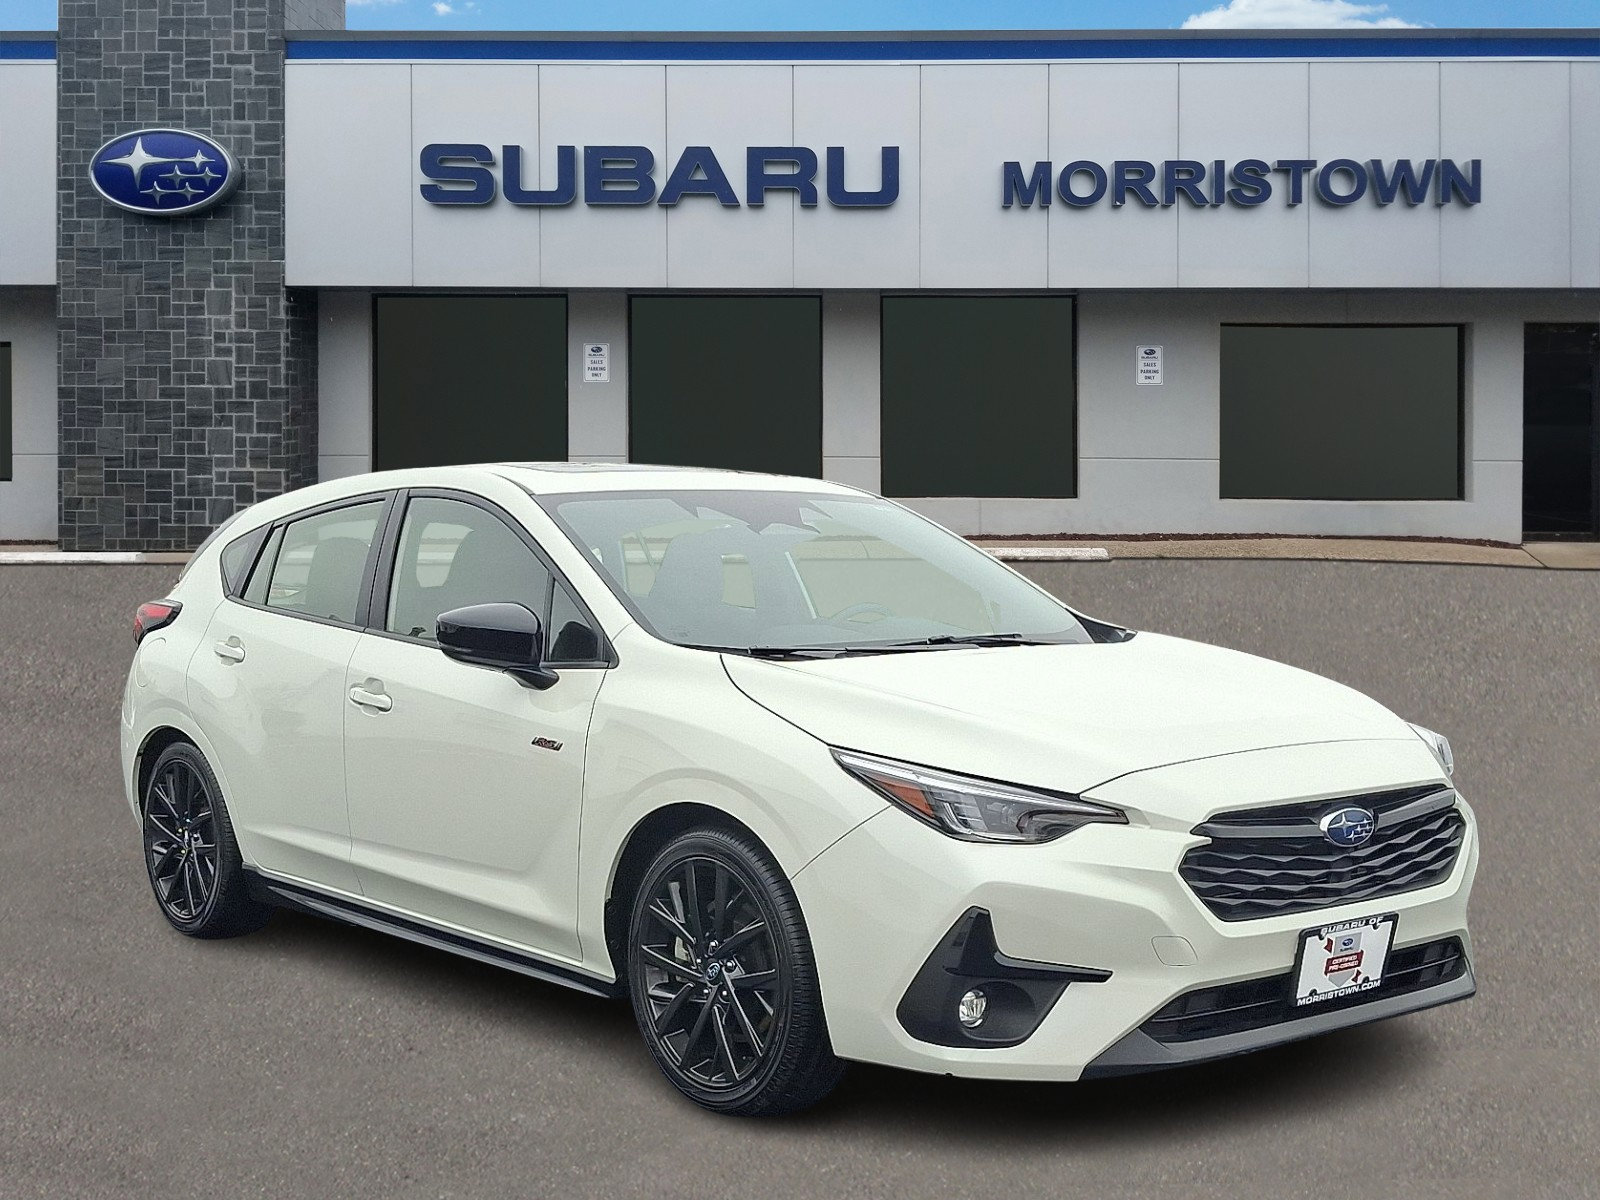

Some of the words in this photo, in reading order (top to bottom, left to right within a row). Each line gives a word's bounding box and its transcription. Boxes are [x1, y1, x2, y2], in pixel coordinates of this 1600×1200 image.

[420, 143, 900, 206] SUBARU
[1002, 159, 1482, 209] MORRISTOWN
[1320, 920, 1366, 935] SUBARU
[1368, 916, 1384, 926] OF
[1328, 960, 1359, 971] PRE-OWNED
[1331, 955, 1358, 965] CERTIFIED
[1297, 980, 1381, 1007] MORRISTOWN.COM
